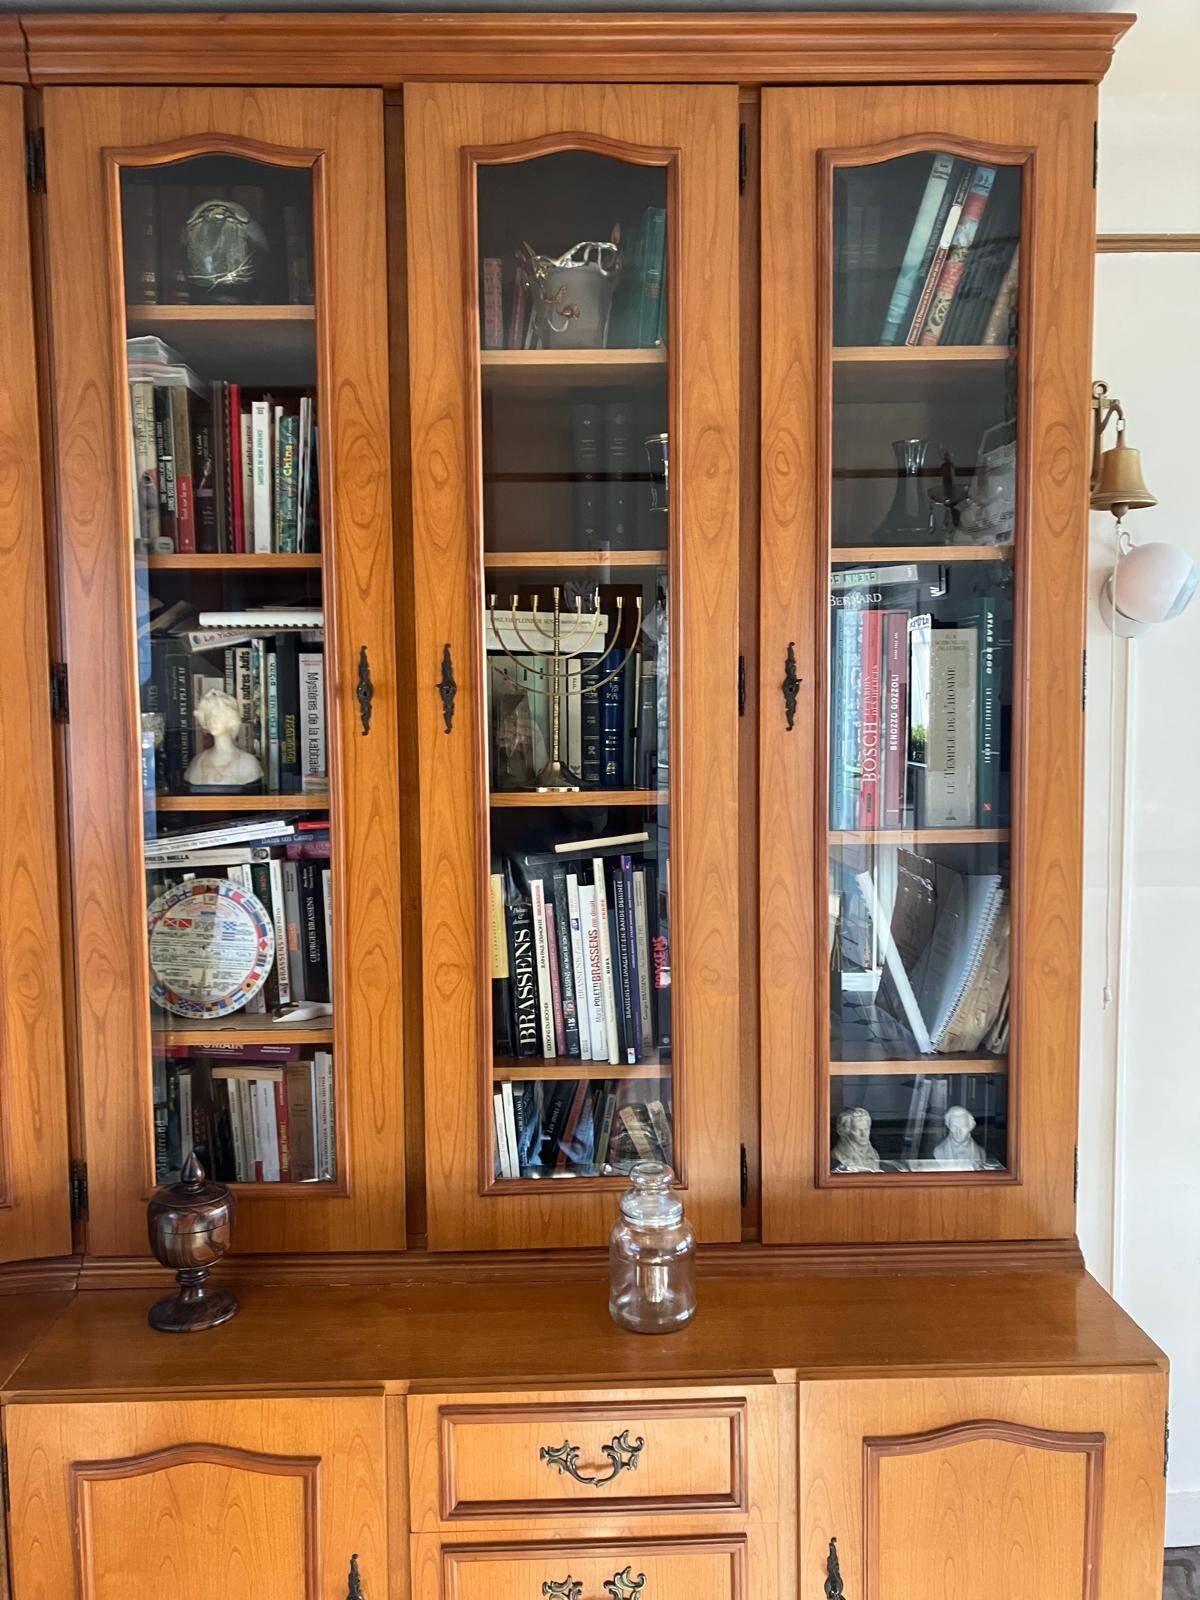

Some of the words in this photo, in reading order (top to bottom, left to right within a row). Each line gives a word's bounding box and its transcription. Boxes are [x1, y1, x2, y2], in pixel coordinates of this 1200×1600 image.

[240, 651, 250, 671] Juifs
[306, 672, 320, 710] Mystères
[891, 674, 899, 709] GOZZOLI
[308, 714, 319, 724] de
[309, 728, 319, 736] la
[890, 712, 898, 750] BENOZZO
[947, 718, 955, 731] DE
[862, 722, 878, 782] BOSCH
[307, 897, 316, 930] BRASSENS
[277, 941, 287, 980] BRASSENS
[587, 929, 603, 982] BRASSENS
[513, 928, 536, 1044] BRASSENS
[564, 972, 573, 996] BRASSENS
[592, 983, 601, 1007] POLETTI
[546, 1124, 555, 1132] Les
[551, 1108, 560, 1122] mots
